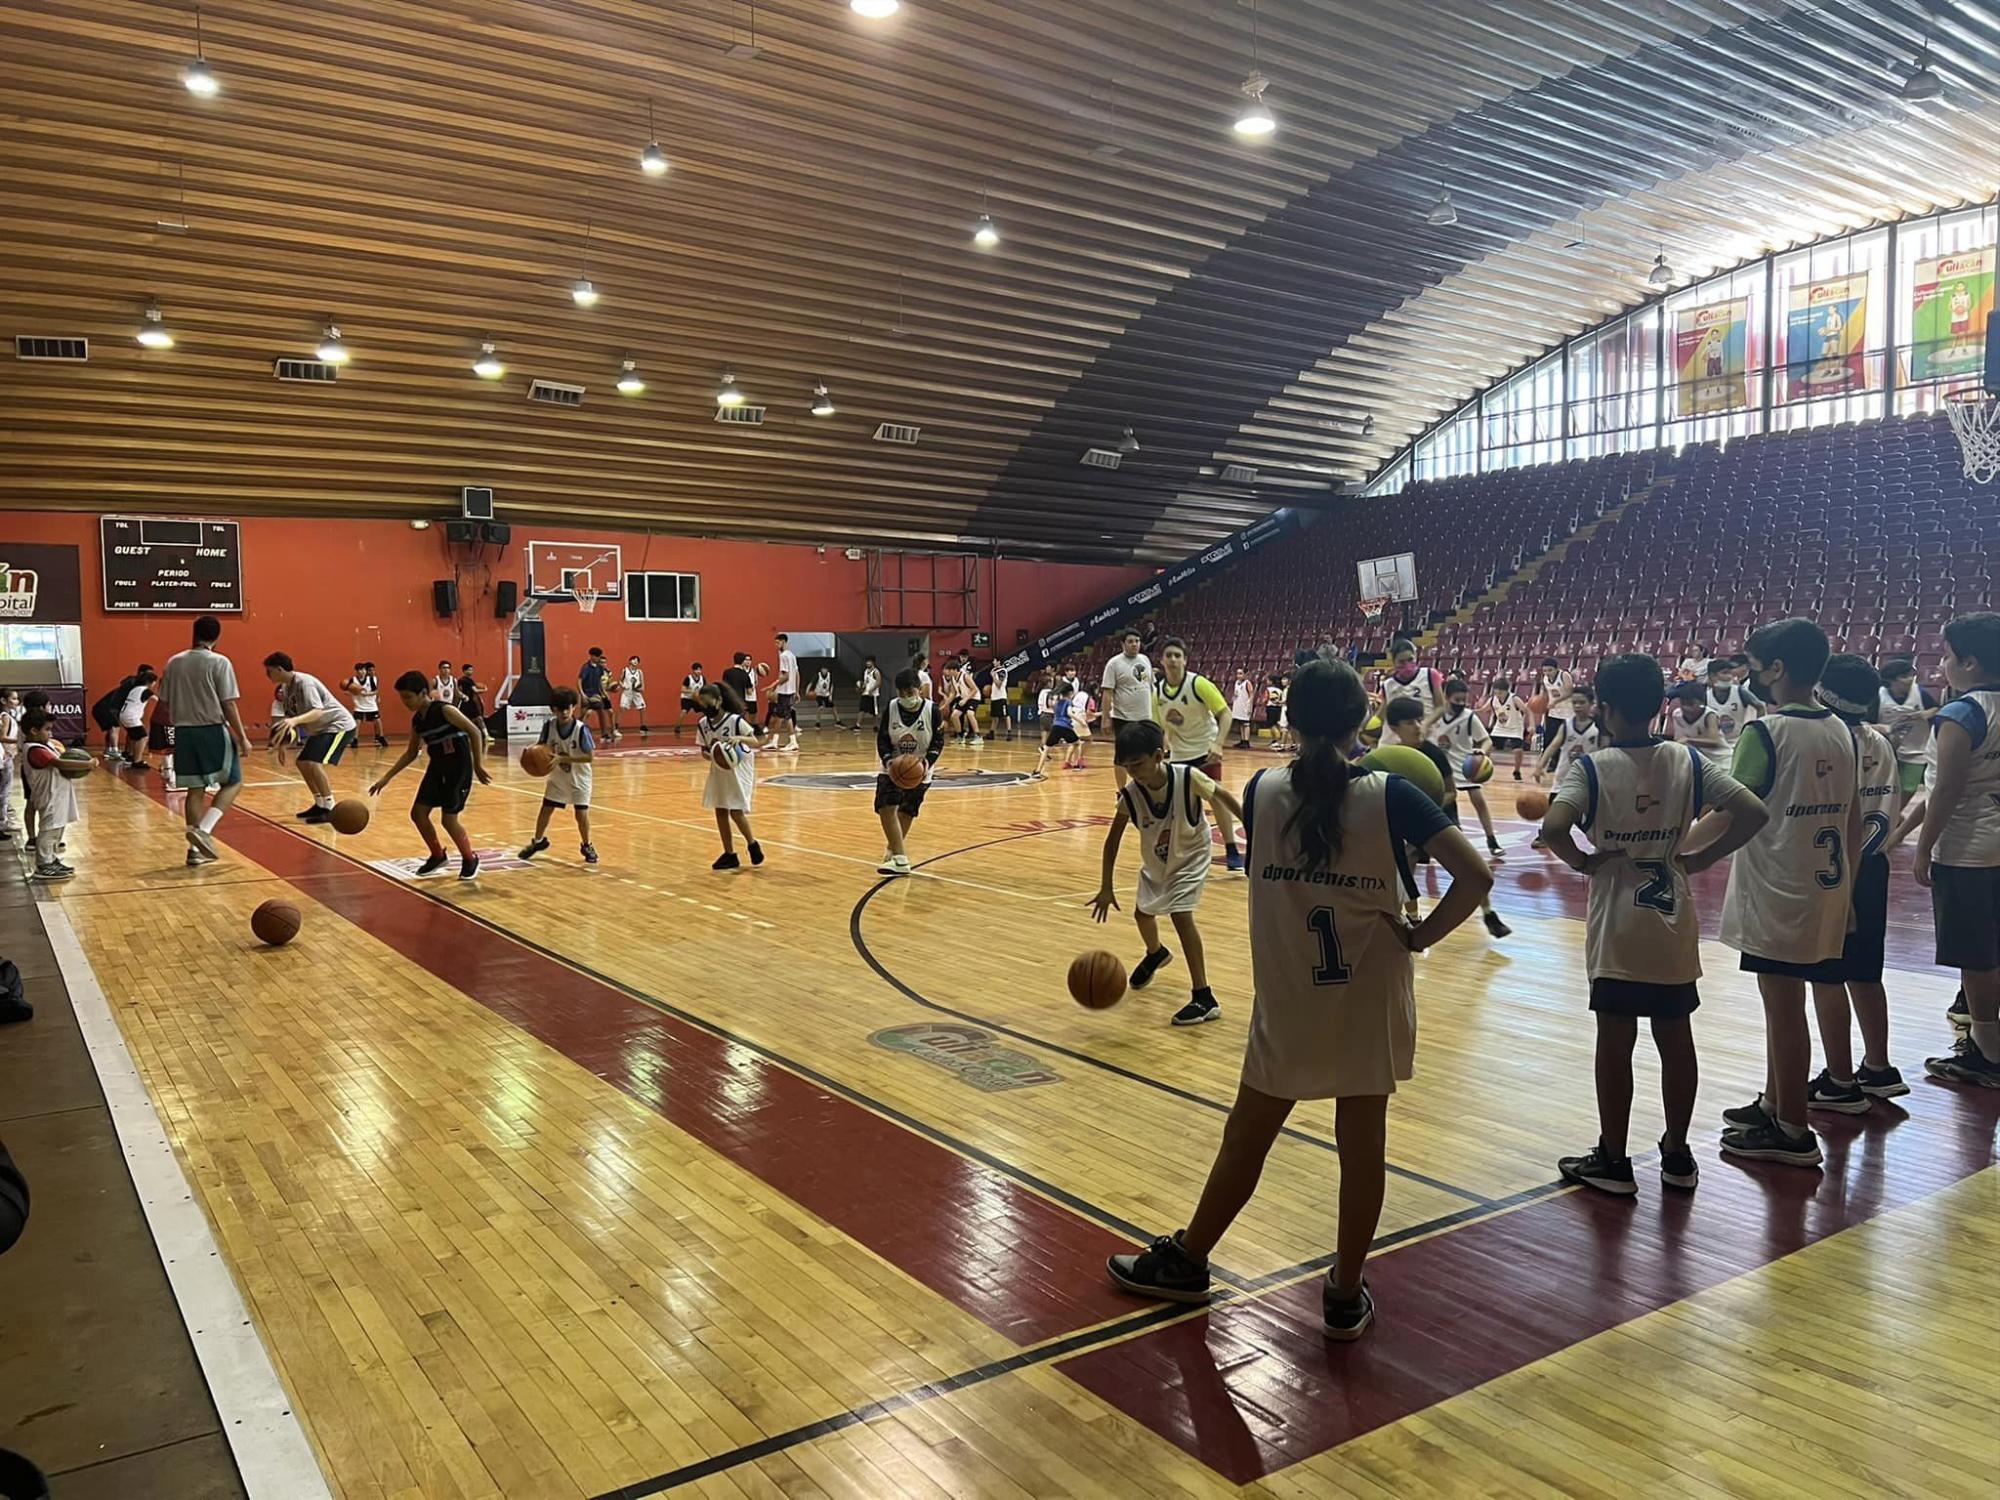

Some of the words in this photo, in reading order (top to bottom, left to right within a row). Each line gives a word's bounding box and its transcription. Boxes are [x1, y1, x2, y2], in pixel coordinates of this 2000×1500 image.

[114, 546, 151, 555] GUEST
[195, 548, 228, 557] HOME
[157, 569, 190, 577] PERIOD
[1414, 688, 1421, 698] 2
[1730, 702, 1738, 712] 3
[917, 720, 924, 731] 2
[722, 727, 730, 736] 2
[570, 741, 577, 749] 3
[1860, 810, 1889, 854] 2
[1813, 825, 1843, 890] 3
[1632, 857, 1677, 915] 2
[1306, 904, 1352, 986] 1
